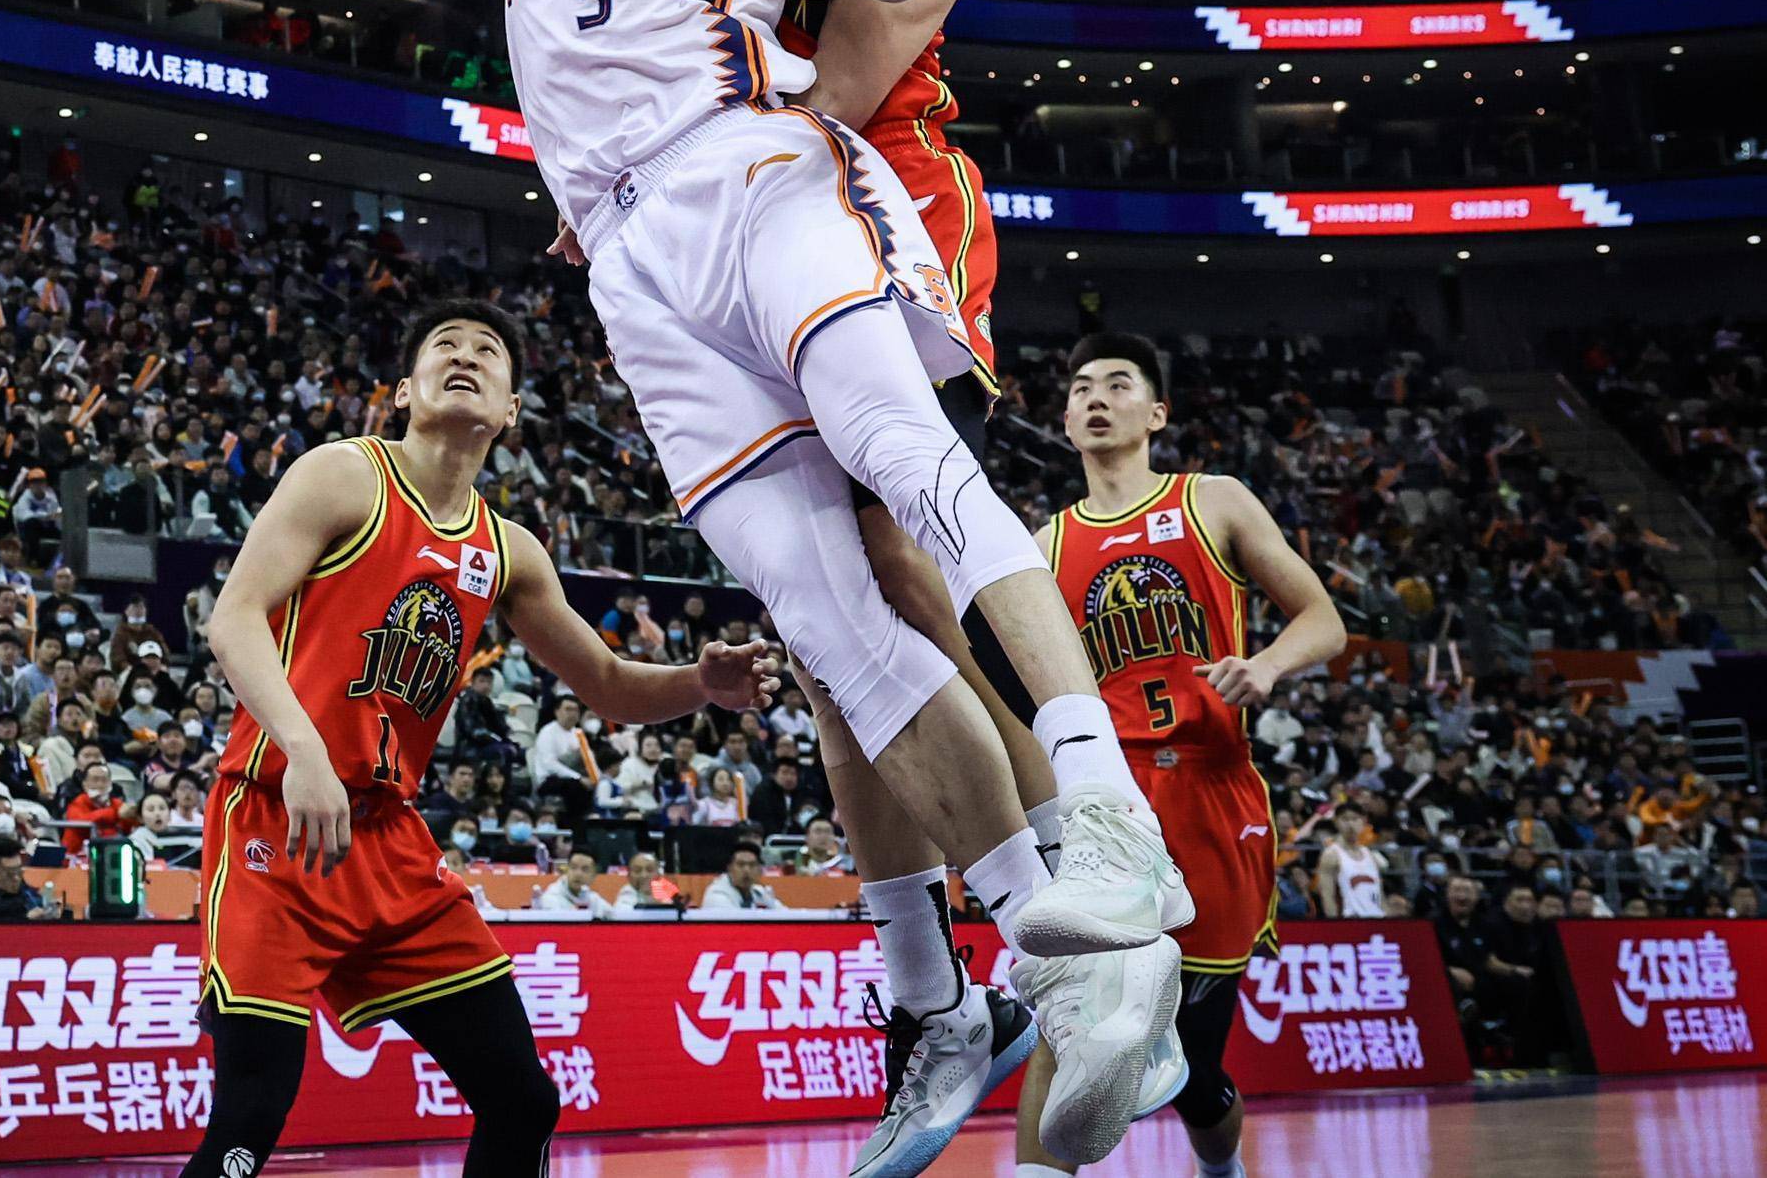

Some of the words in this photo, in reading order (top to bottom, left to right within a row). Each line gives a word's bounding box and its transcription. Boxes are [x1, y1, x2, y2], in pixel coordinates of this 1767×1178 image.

[1265, 17, 1363, 38] SHANGHAI
[1410, 13, 1487, 35] SHARKS
[94, 40, 269, 102] 奉献人民满意赛事
[983, 192, 1054, 220] 意赛事
[1313, 202, 1414, 223] SHANGHAI
[1450, 198, 1530, 219] SHARKS
[348, 628, 460, 722] JLIN
[1142, 677, 1176, 732] 5
[675, 938, 895, 1065] 红双喜
[1239, 934, 1410, 1044] 红双喜
[1613, 931, 1737, 1028] 红双喜
[1300, 1015, 1425, 1074] 羽球器材
[1663, 1005, 1754, 1056] 乒乓器材
[412, 1045, 600, 1117] 足球
[758, 1038, 888, 1103] 足篮排
